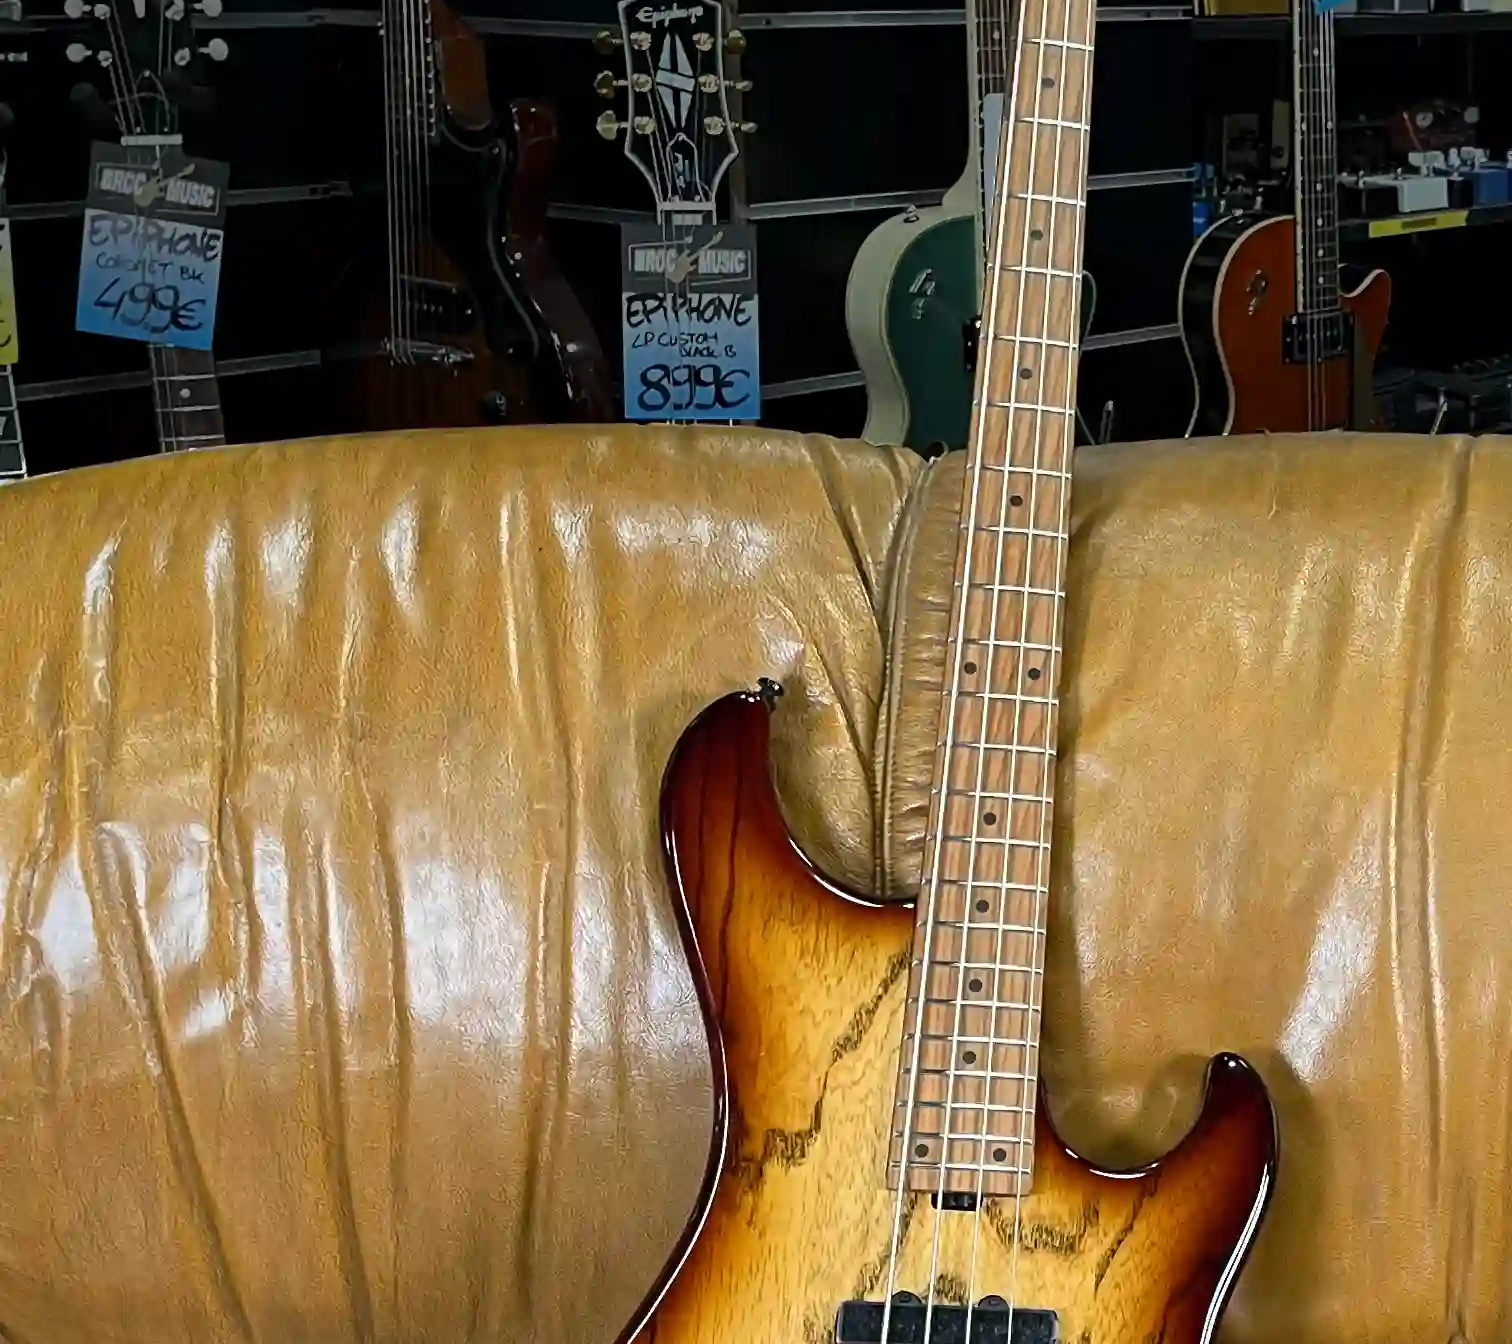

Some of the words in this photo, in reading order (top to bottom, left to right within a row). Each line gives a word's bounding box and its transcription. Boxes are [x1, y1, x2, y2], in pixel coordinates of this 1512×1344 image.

[165, 178, 216, 208] MUSIC
[698, 249, 747, 274] MUSIC
[637, 363, 751, 412] 899€
